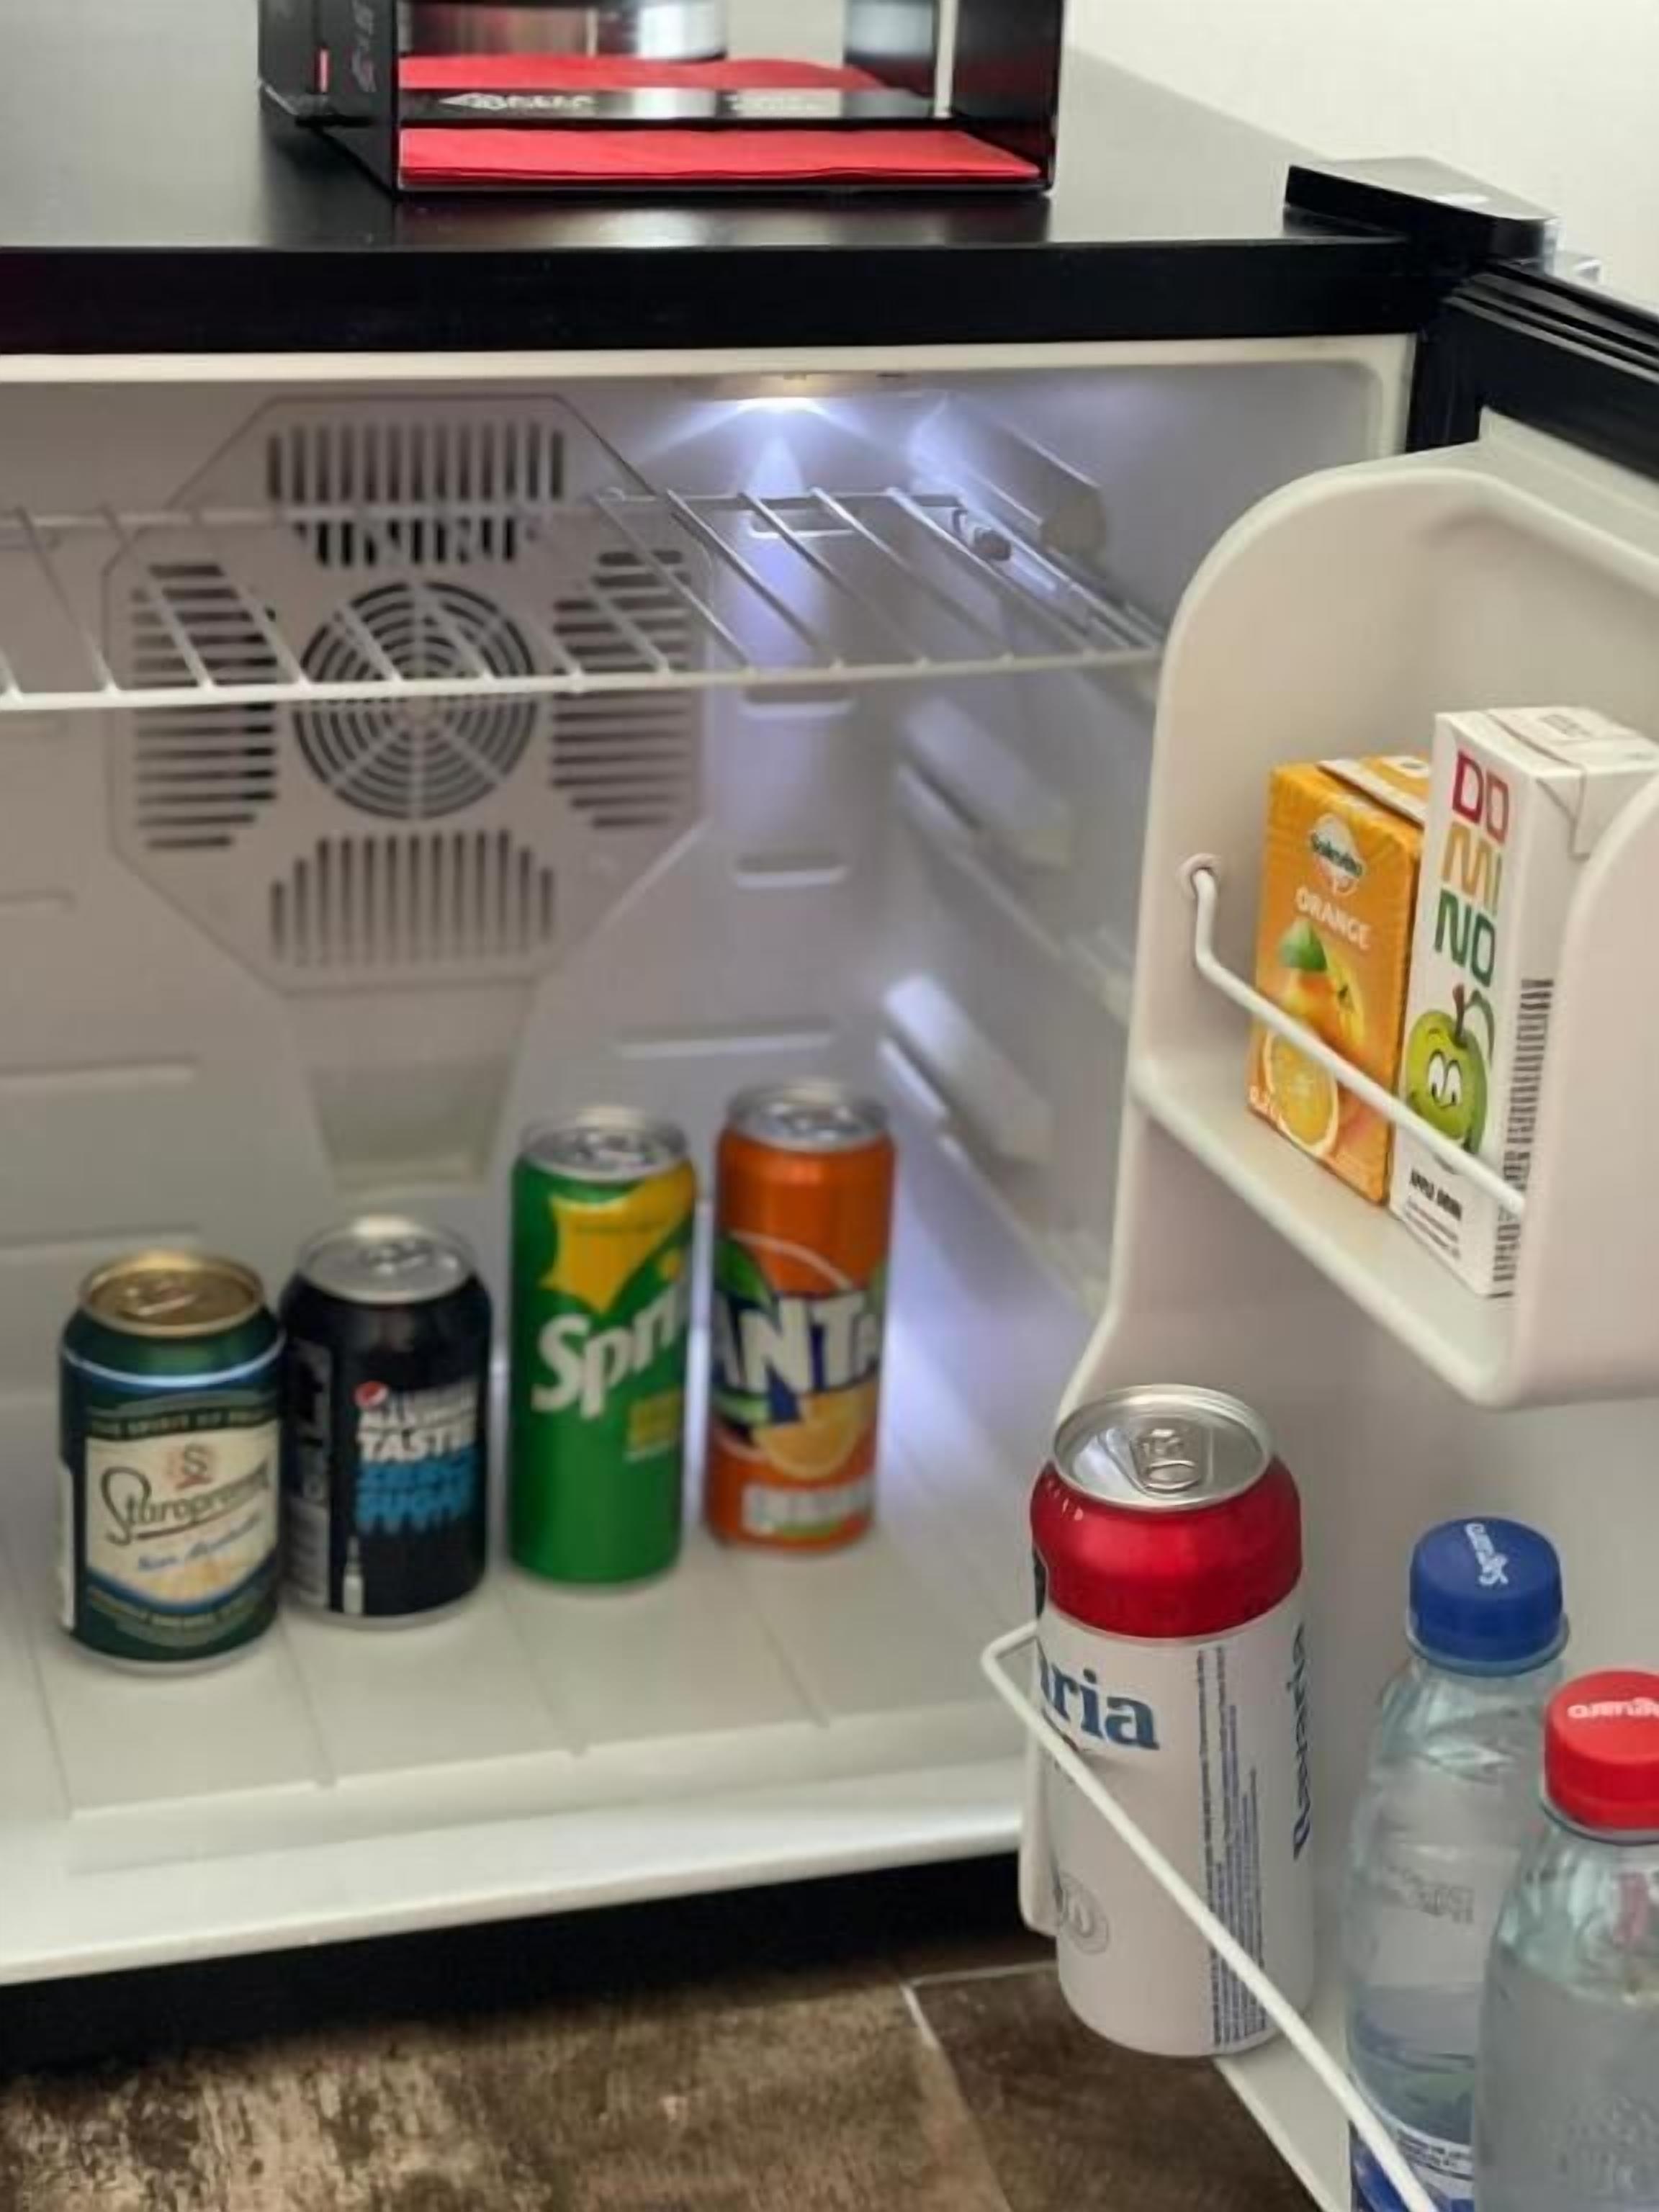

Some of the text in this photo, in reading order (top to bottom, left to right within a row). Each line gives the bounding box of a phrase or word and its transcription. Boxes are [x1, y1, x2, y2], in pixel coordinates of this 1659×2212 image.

[1452, 750, 1509, 848] DO
[1295, 886, 1372, 952] ORANGE
[1441, 822, 1503, 918] MI
[1433, 888, 1496, 989] NO
[1040, 1645, 1160, 1750] ria
